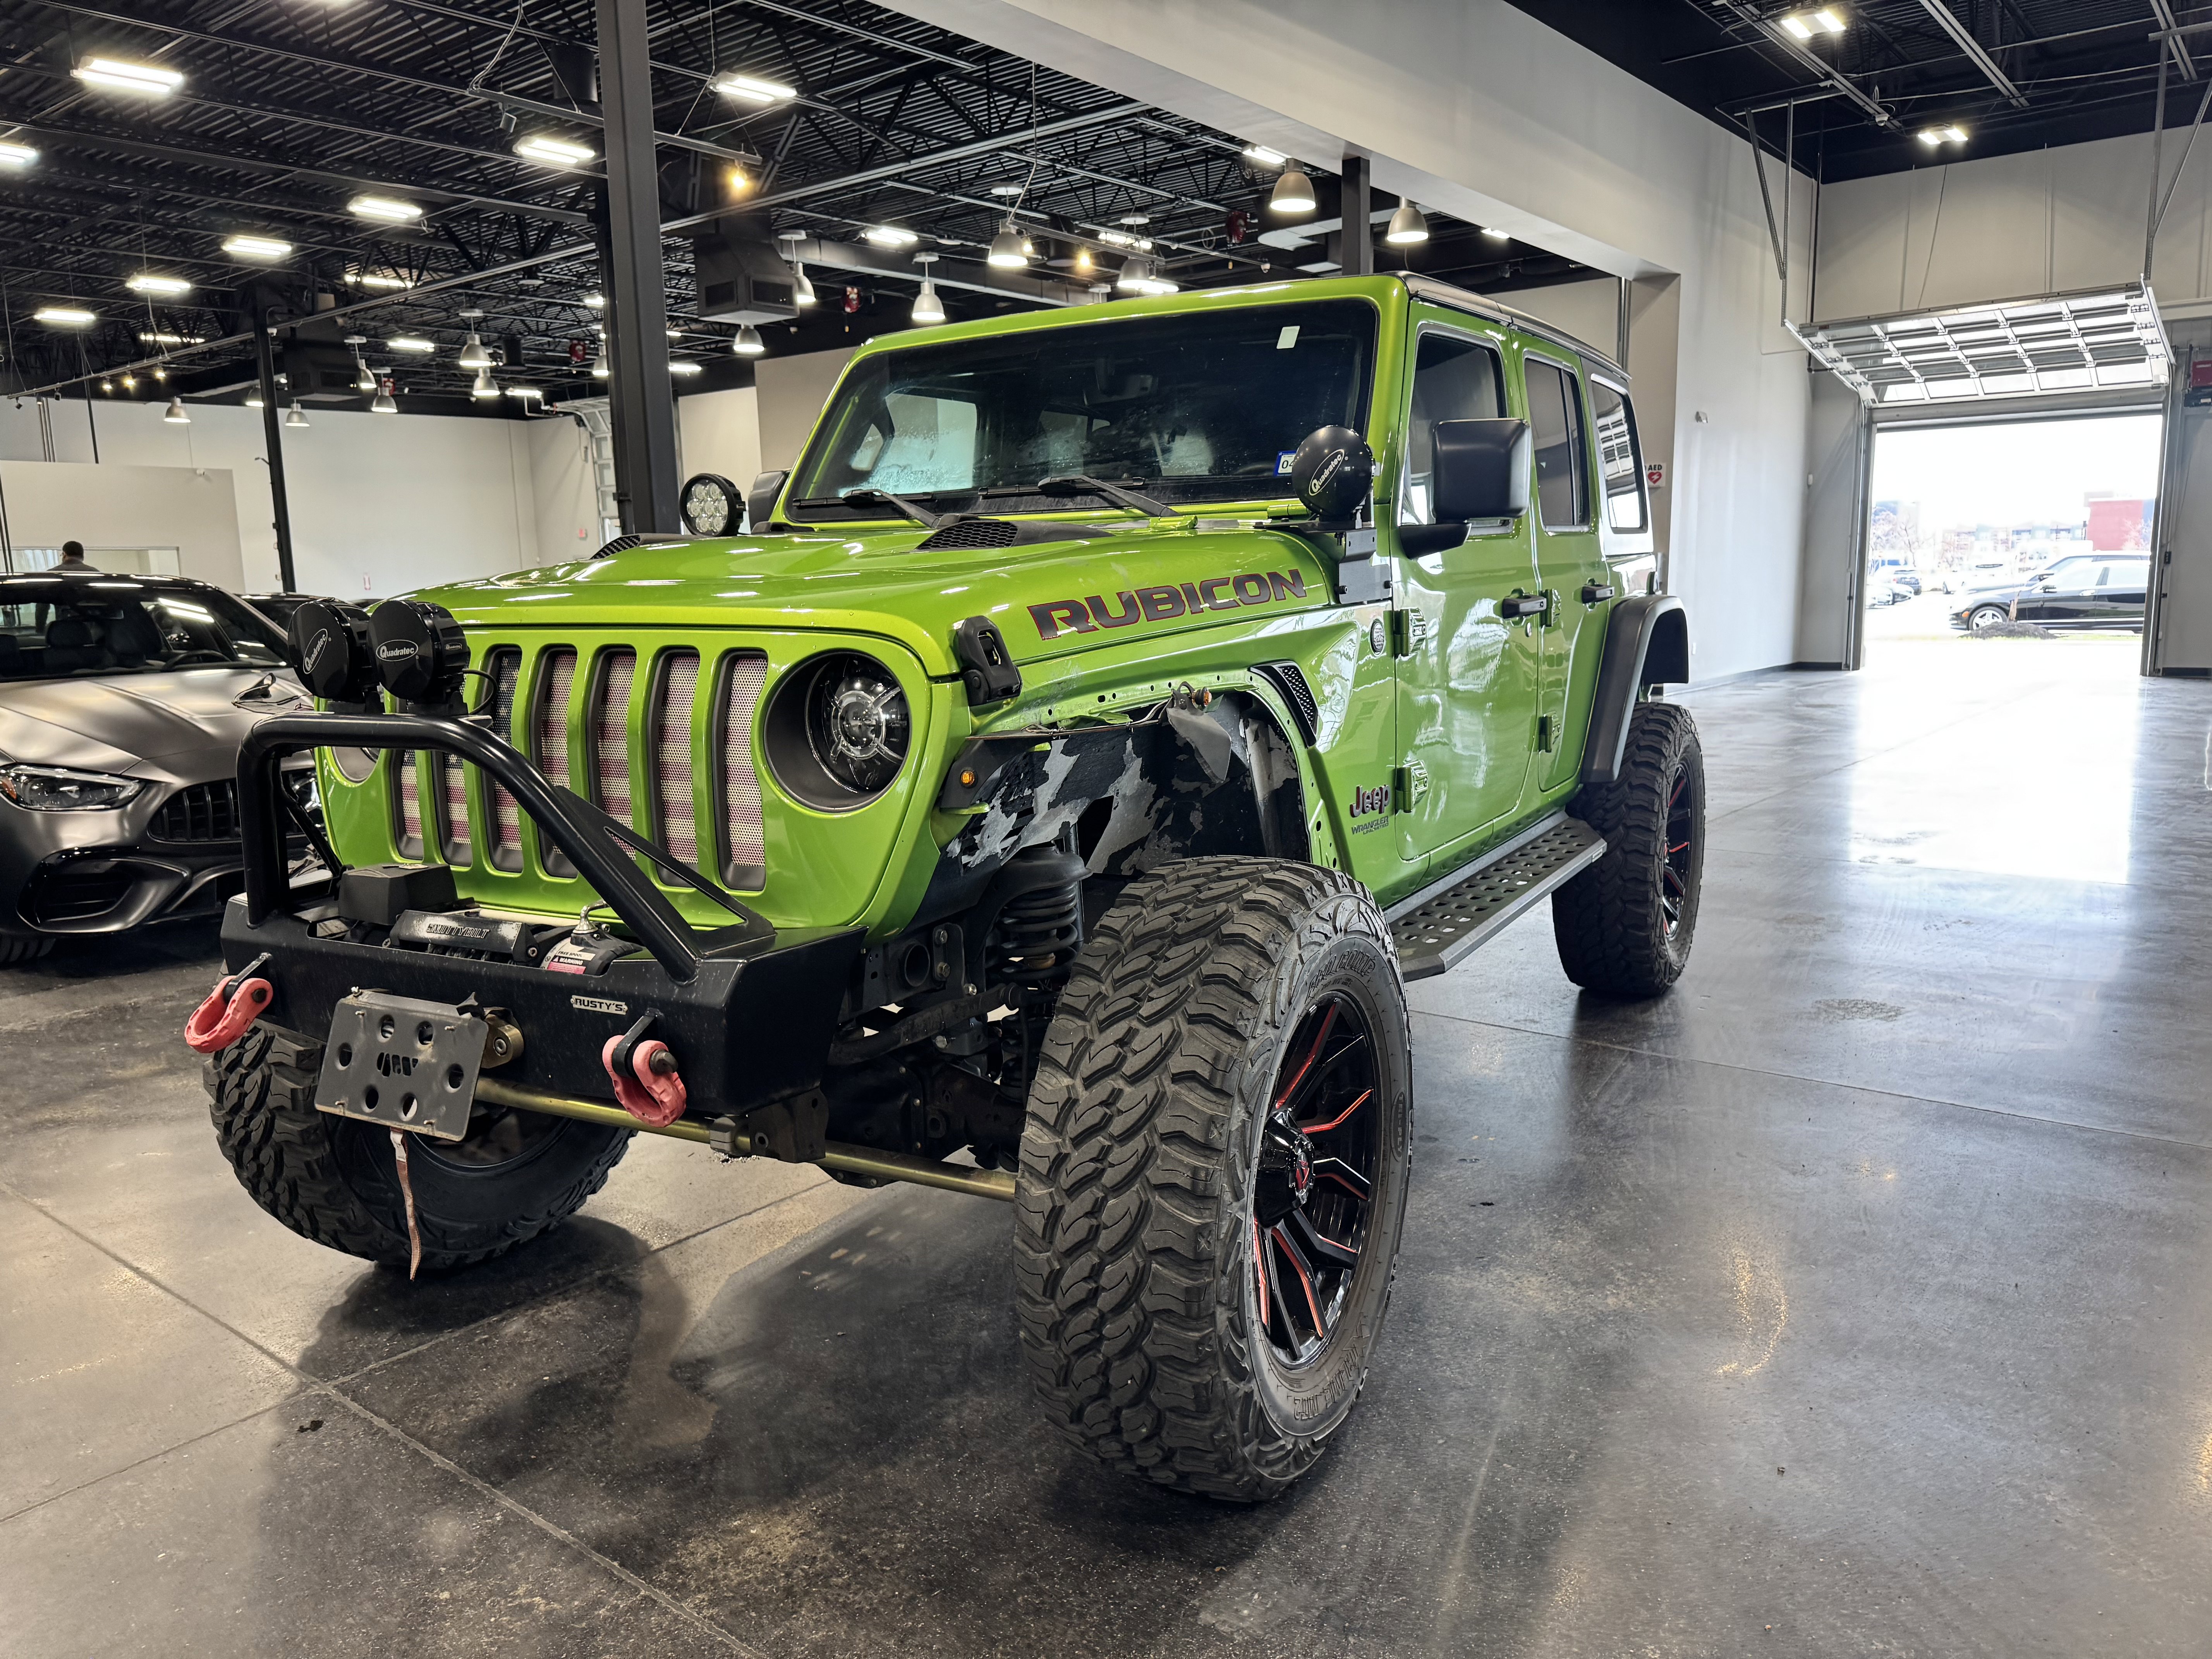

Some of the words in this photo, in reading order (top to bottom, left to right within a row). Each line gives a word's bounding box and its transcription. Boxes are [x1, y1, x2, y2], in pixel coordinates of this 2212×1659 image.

[1311, 453, 1342, 493] Quadratec
[1027, 569, 1307, 640] RUBICON
[304, 634, 326, 672] Quadratec
[380, 645, 414, 659] Quadratec
[1350, 784, 1391, 818] Jeep
[1352, 816, 1389, 835] WRANGLER
[1363, 822, 1389, 835] UNLIMITED
[427, 923, 490, 939] SMITTYBILT
[575, 998, 623, 1011] RUSTY'S
